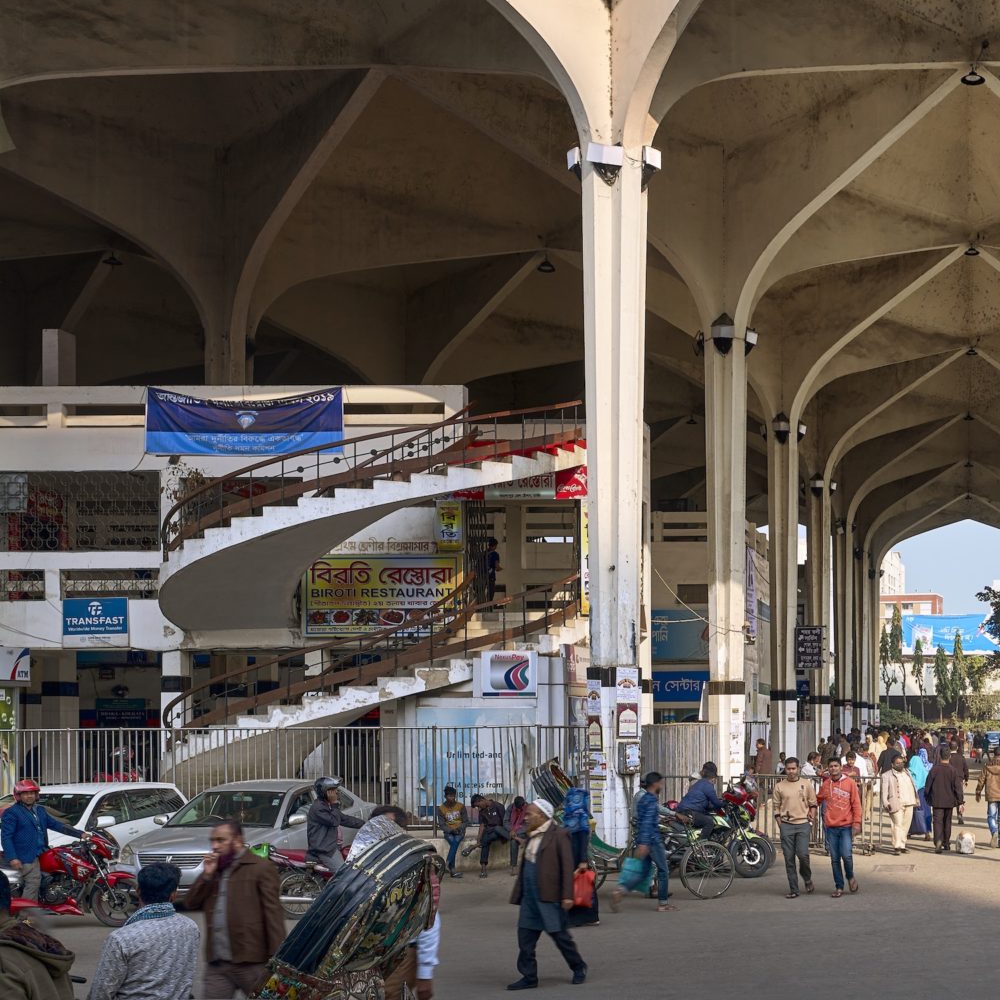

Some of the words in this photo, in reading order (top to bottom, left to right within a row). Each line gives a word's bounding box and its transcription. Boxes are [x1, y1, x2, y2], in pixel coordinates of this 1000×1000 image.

[306, 393, 335, 404] ২০১৯
[310, 561, 372, 585] বিরতি
[379, 567, 453, 587] রেস্তোরা
[311, 588, 356, 598] BIROTI
[361, 588, 453, 598] RESTAURANT
[65, 616, 125, 626] TRANSFAST
[494, 653, 525, 661] NexusPay
[17, 670, 29, 678] ATM
[665, 677, 700, 692] সেন্টার
